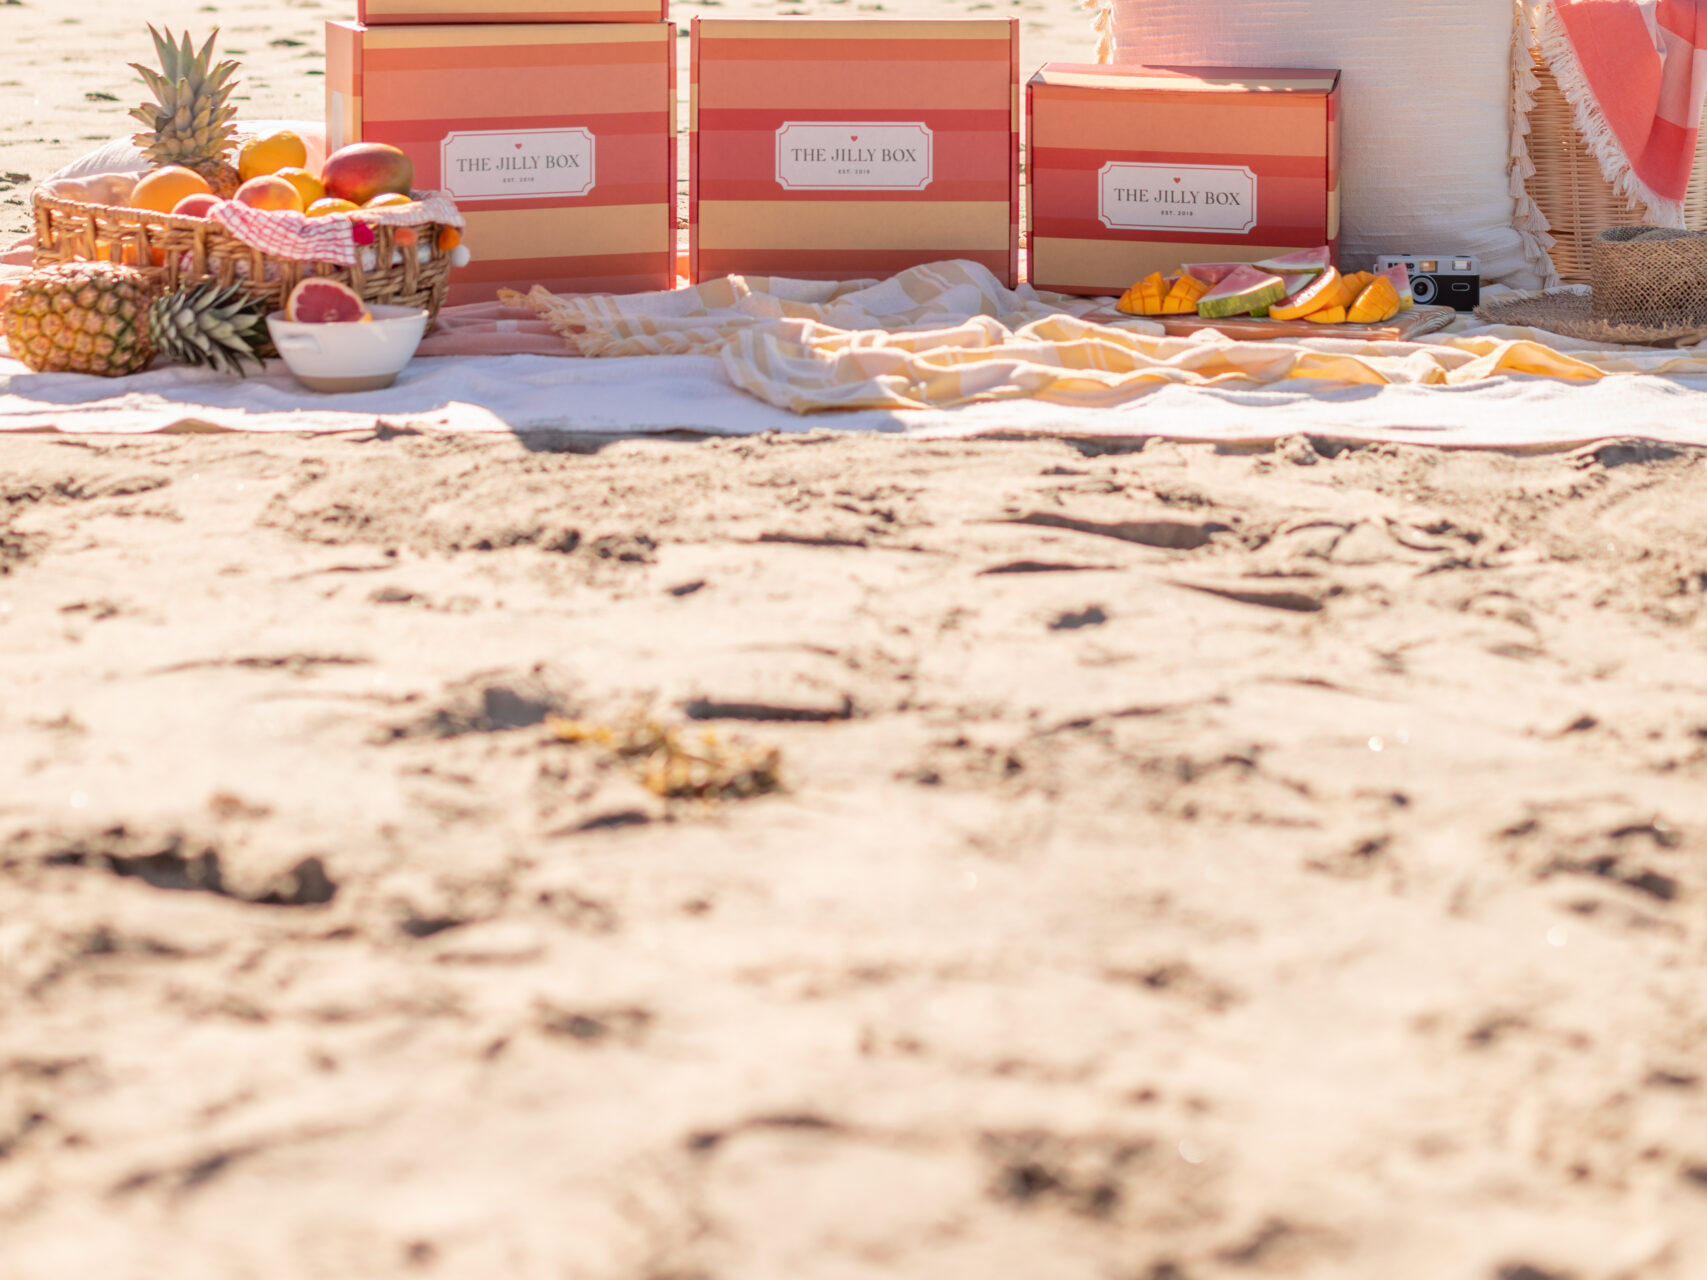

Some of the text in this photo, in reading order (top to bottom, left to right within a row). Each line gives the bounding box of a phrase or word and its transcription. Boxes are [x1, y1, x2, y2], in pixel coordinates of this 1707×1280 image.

[456, 154, 580, 172] THE JILLY BOX
[791, 148, 917, 162] THE JILLY BOX
[1113, 188, 1241, 206] THE JILLY BOX
